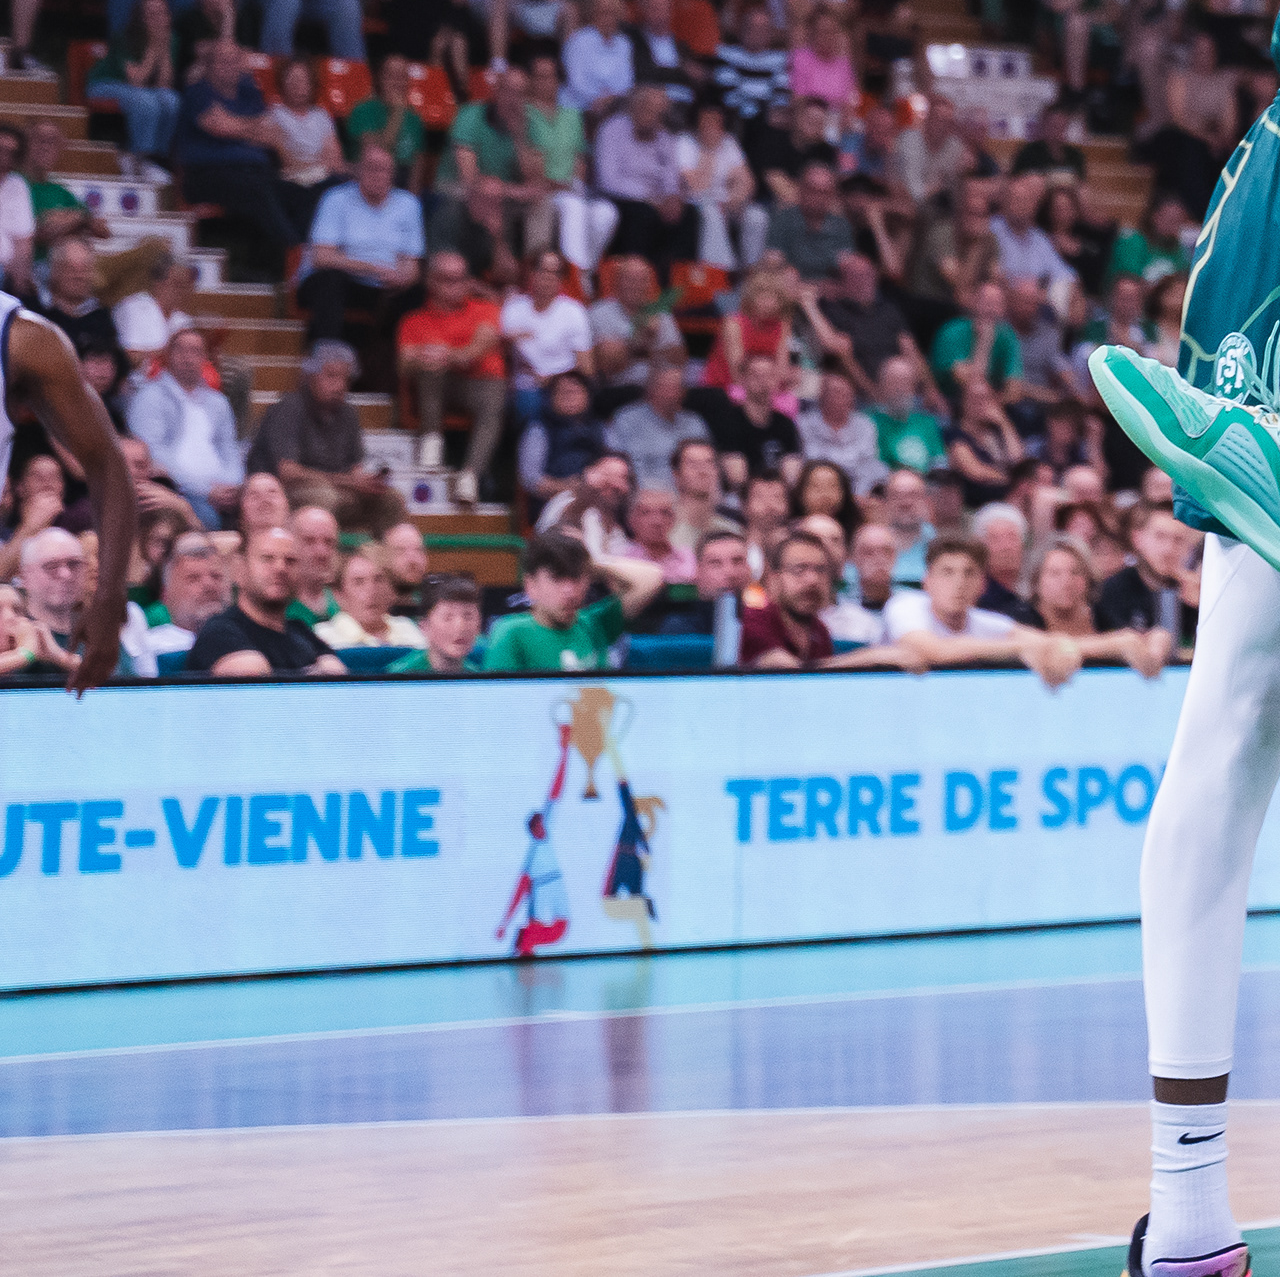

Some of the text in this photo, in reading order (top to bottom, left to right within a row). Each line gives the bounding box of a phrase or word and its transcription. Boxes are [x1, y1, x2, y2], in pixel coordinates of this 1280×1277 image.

[725, 762, 1168, 843] TERRE DE SPO
